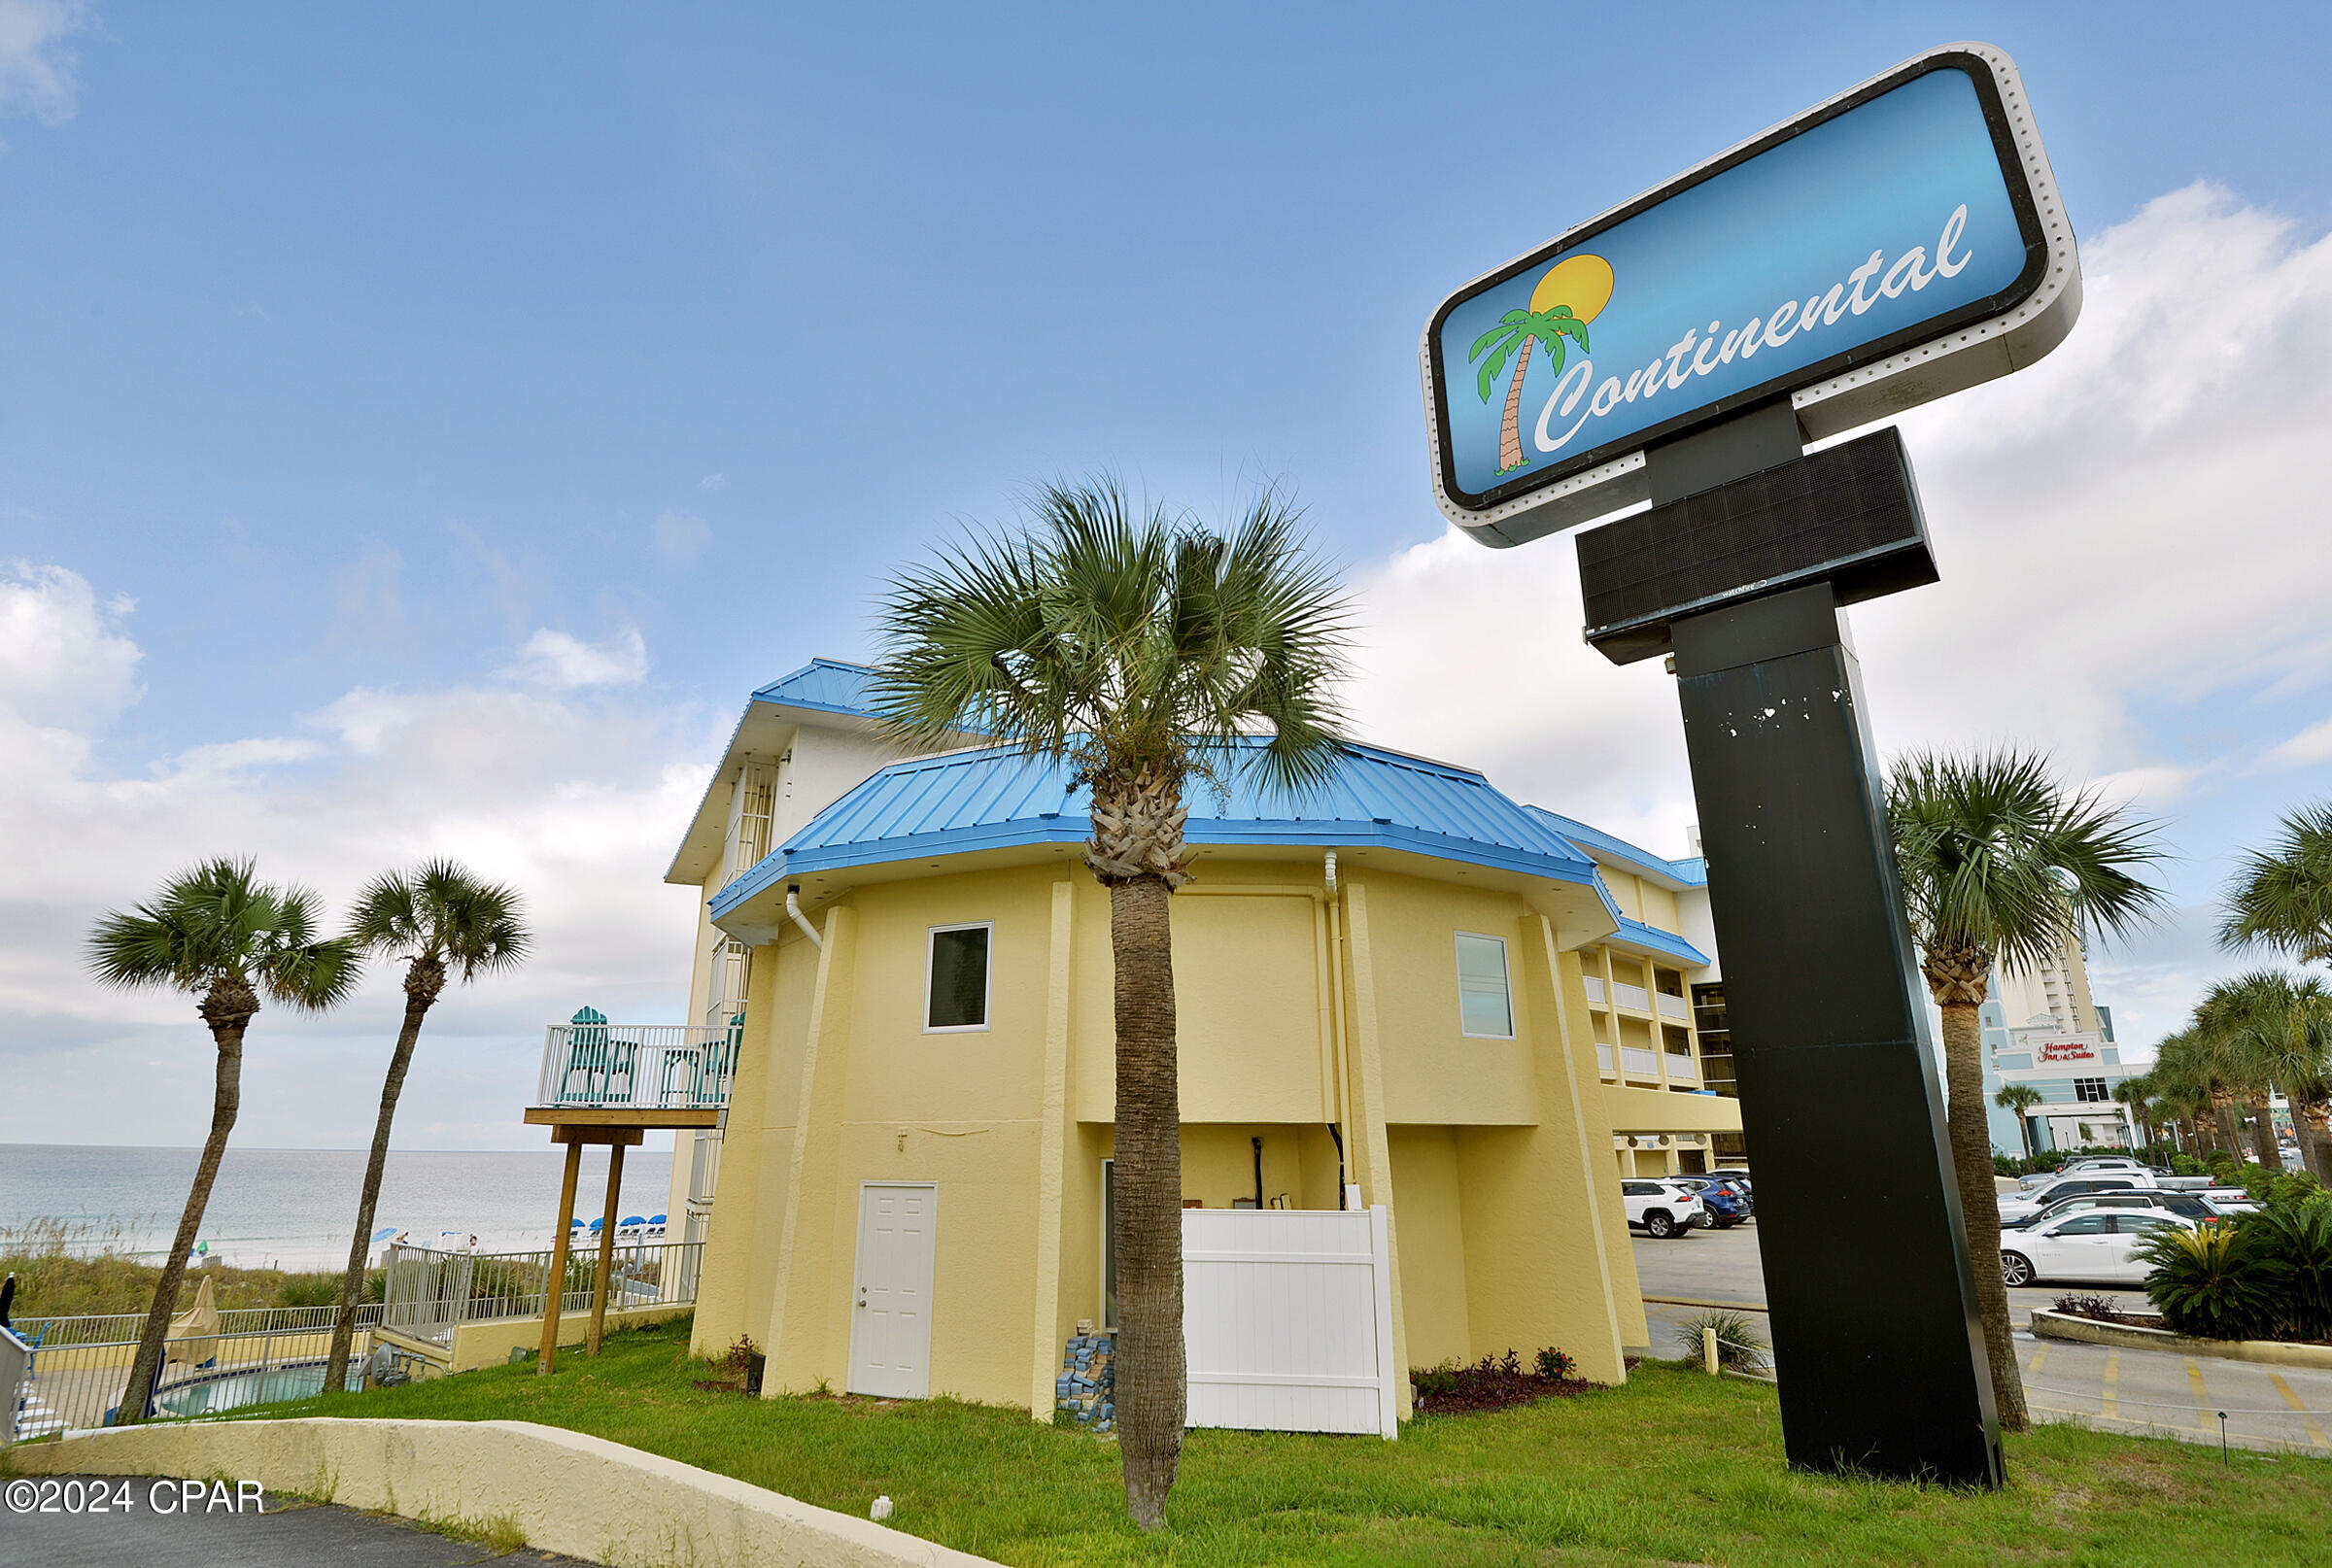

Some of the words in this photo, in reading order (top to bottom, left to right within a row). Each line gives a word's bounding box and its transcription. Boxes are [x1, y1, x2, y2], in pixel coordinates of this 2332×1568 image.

[1533, 203, 1973, 453] Continental
[2040, 1042, 2088, 1053] Hampton
[2038, 1053, 2062, 1063] Inn
[2070, 1051, 2095, 1060] Suites
